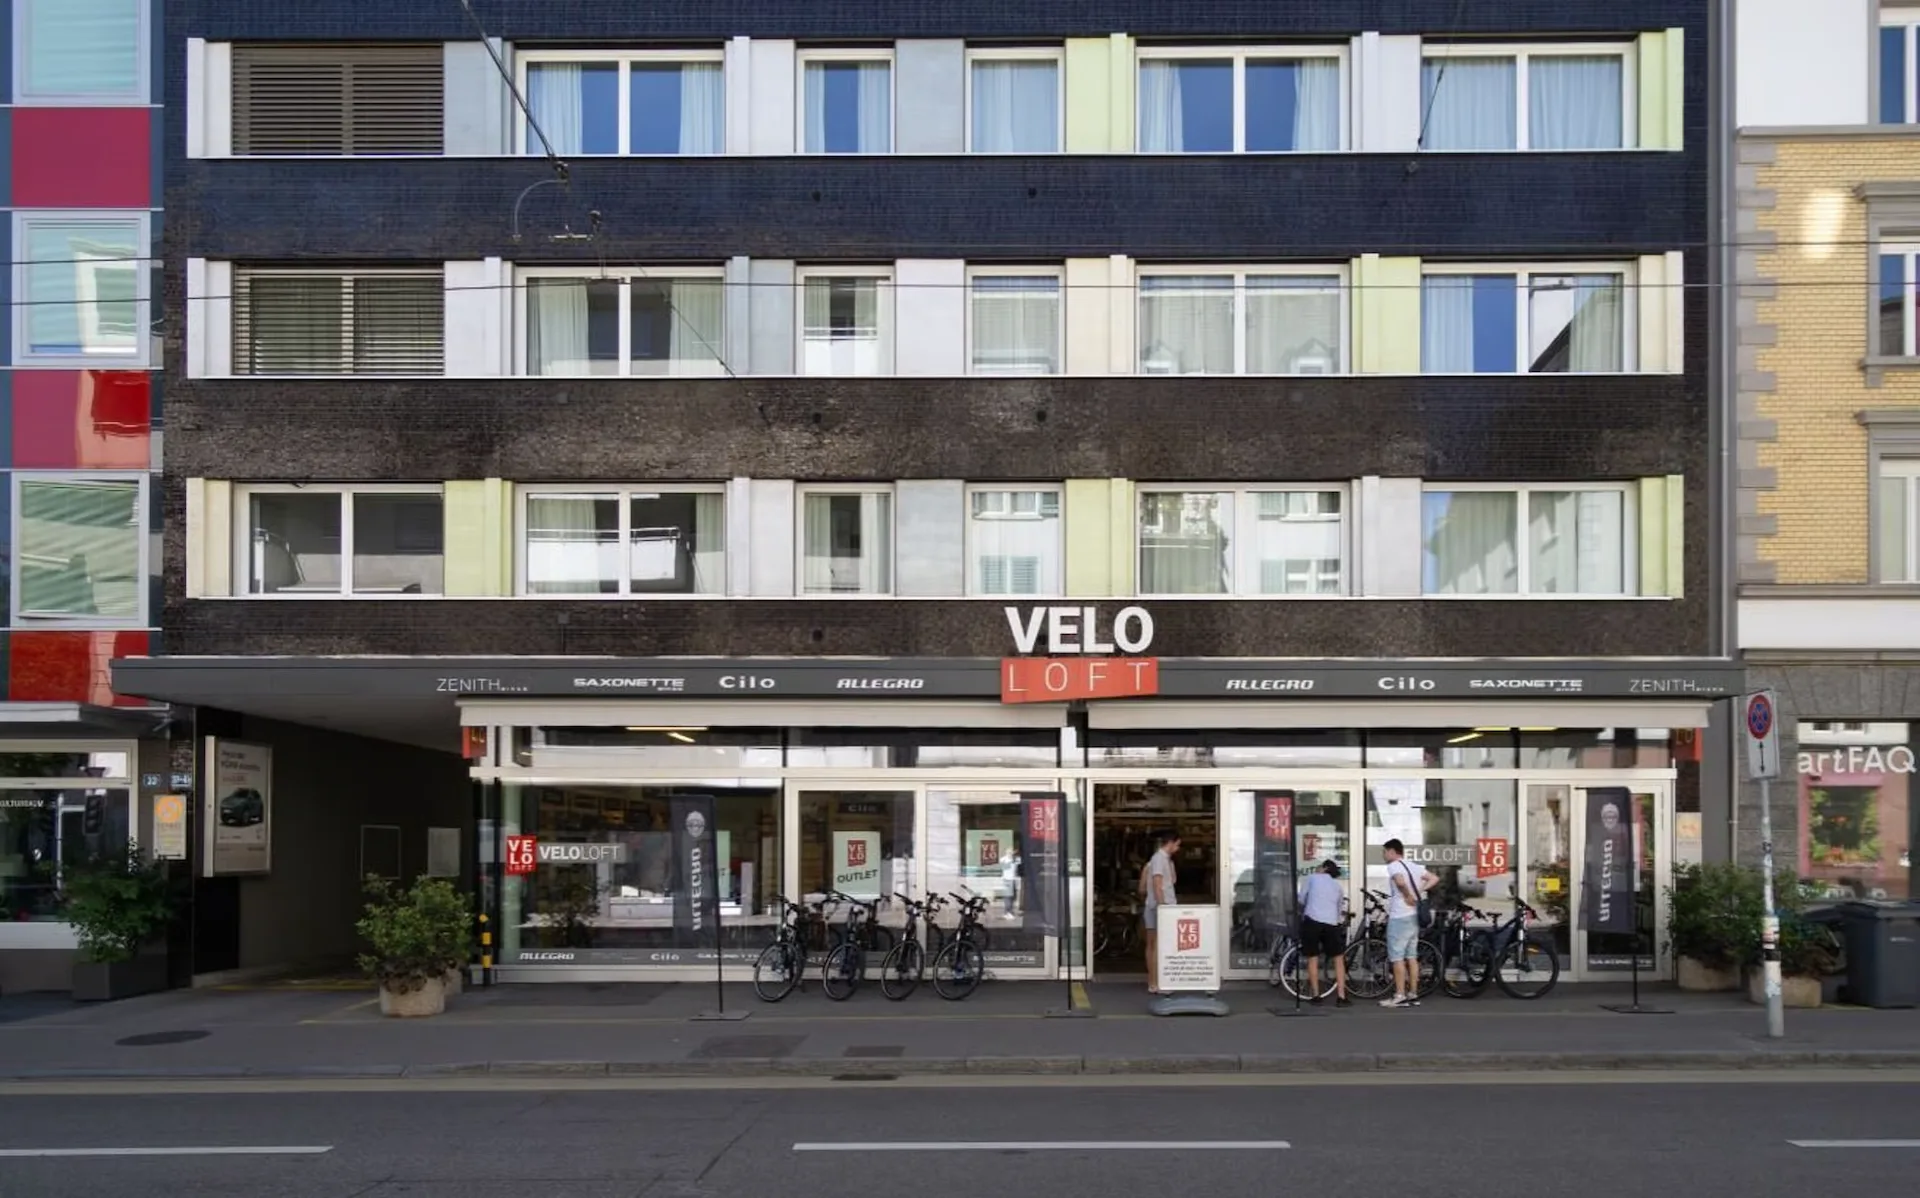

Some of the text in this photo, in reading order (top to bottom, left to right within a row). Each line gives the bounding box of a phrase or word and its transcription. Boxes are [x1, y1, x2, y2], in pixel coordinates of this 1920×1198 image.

[1004, 606, 1154, 654] VELO
[573, 678, 685, 687] SAXONETTE
[719, 676, 776, 689] Cilo
[1009, 661, 1151, 692] LOFT
[1378, 676, 1436, 690] Cilo
[436, 678, 500, 692] ZENITH
[836, 678, 925, 689] ALLEGRO
[1226, 679, 1314, 690] ALLEGRO
[1469, 679, 1583, 688] SAXONETTE
[1629, 679, 1695, 692] ZENITH
[1797, 746, 1918, 774] artFAQ
[1404, 847, 1473, 862] ELOLOFT
[837, 869, 878, 884] OUTLET
[519, 952, 575, 960] ALLEGRO
